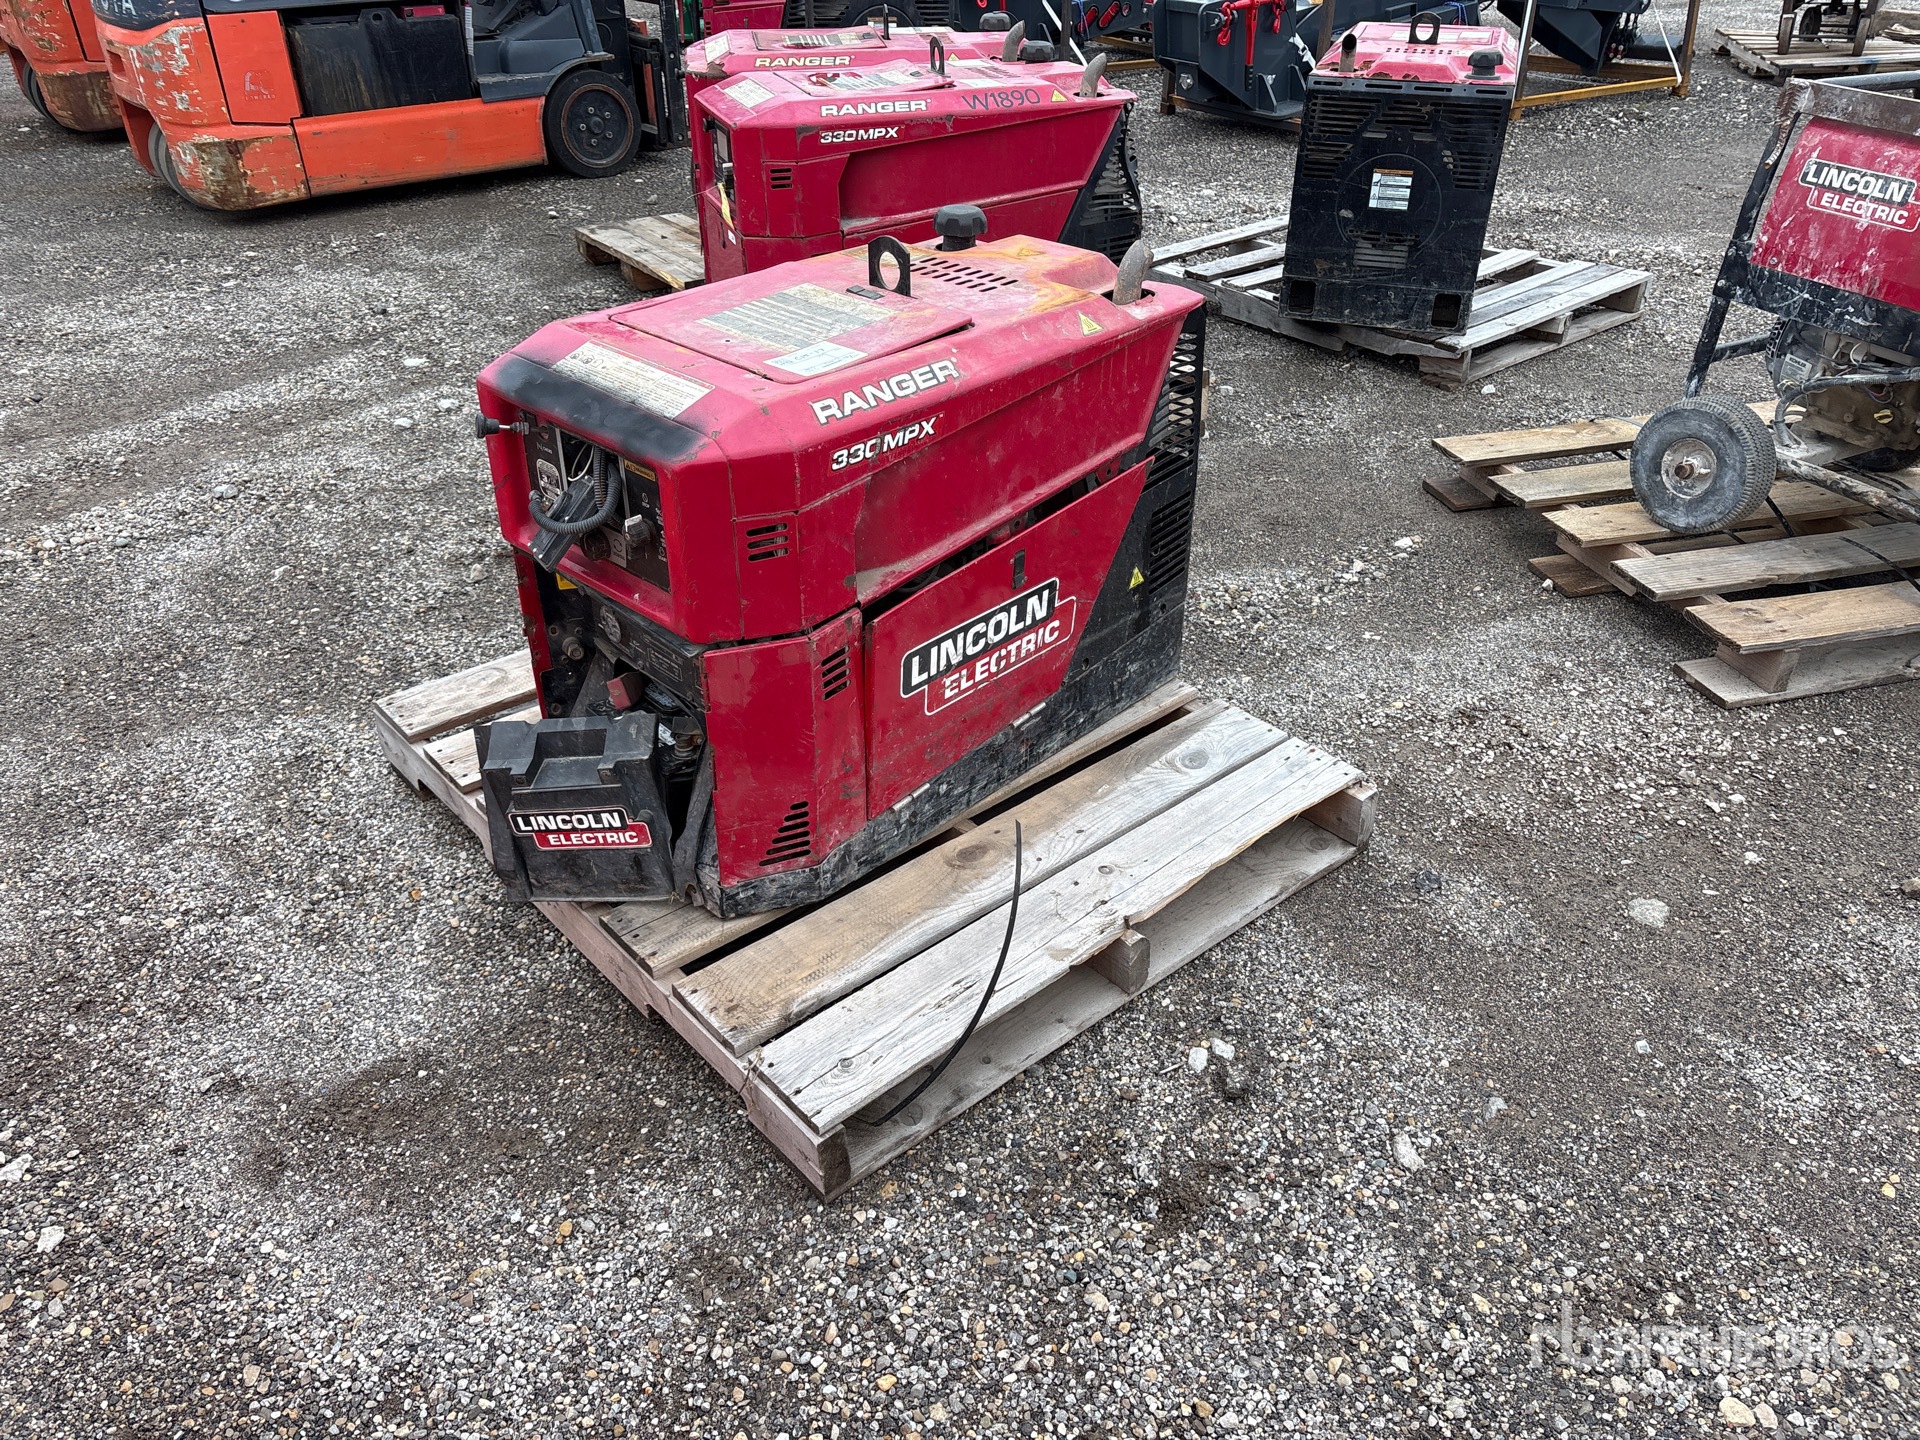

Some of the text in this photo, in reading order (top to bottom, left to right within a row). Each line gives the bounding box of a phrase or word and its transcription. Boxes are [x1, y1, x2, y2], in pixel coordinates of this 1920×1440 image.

[755, 56, 851, 67] RANGER
[821, 100, 928, 117] RANGER
[961, 88, 1041, 110] W1890
[819, 127, 899, 143] 330MPX
[1805, 164, 1909, 203] LINCOLN
[1819, 192, 1909, 225] ELECTRIC
[811, 359, 960, 425] RANGER
[911, 588, 1050, 687] LINCOLN
[942, 619, 1061, 699] ELECTRIC
[516, 812, 622, 831] LINCOLN
[547, 831, 639, 846] ELECTRIC
